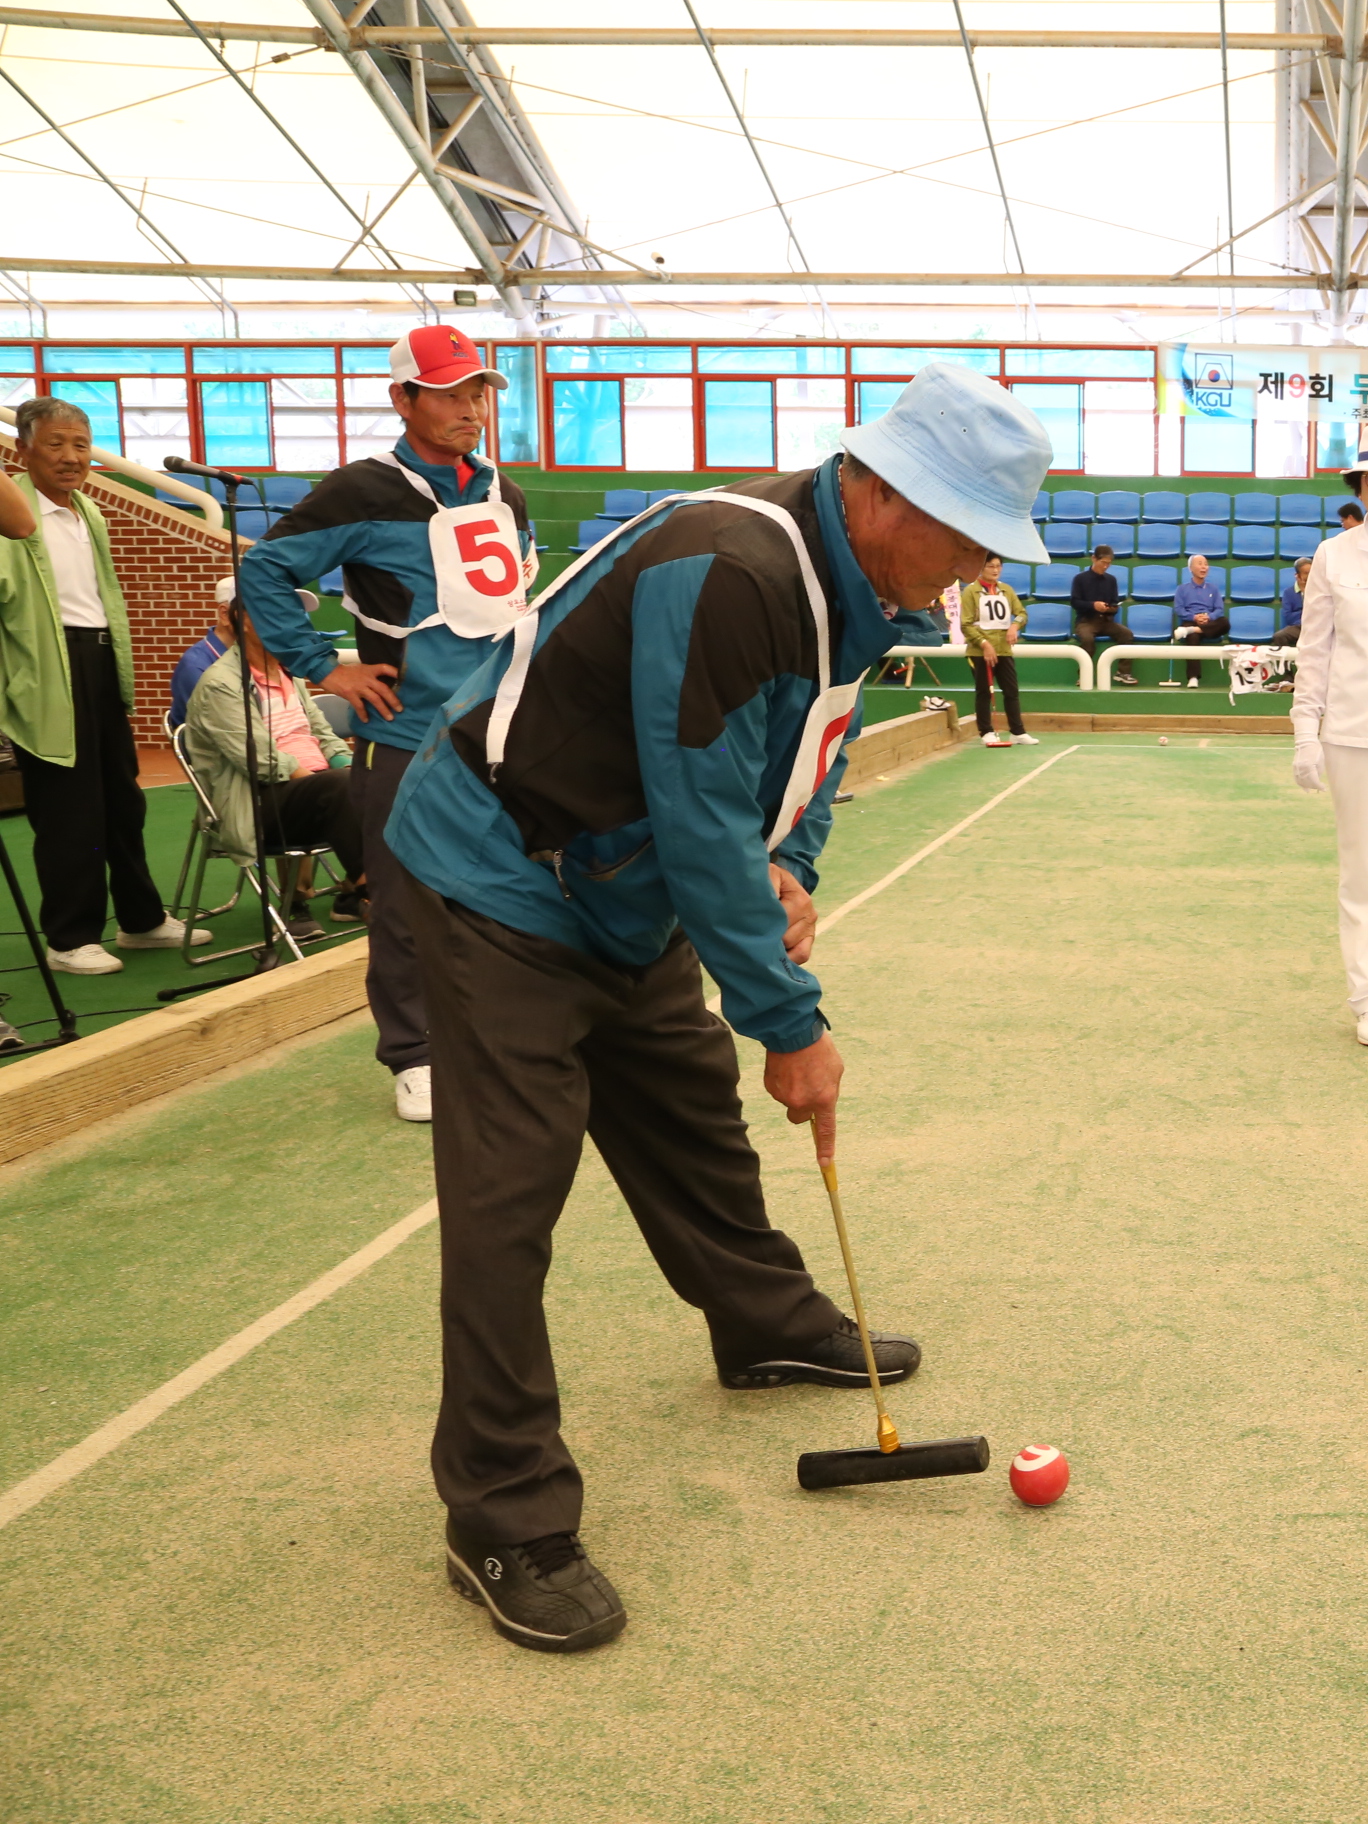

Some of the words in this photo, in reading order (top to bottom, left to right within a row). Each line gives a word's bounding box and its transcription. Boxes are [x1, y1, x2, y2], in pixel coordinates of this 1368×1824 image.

[1258, 372, 1333, 403] 제9회
[453, 518, 519, 597] 5
[985, 600, 1006, 620] 10
